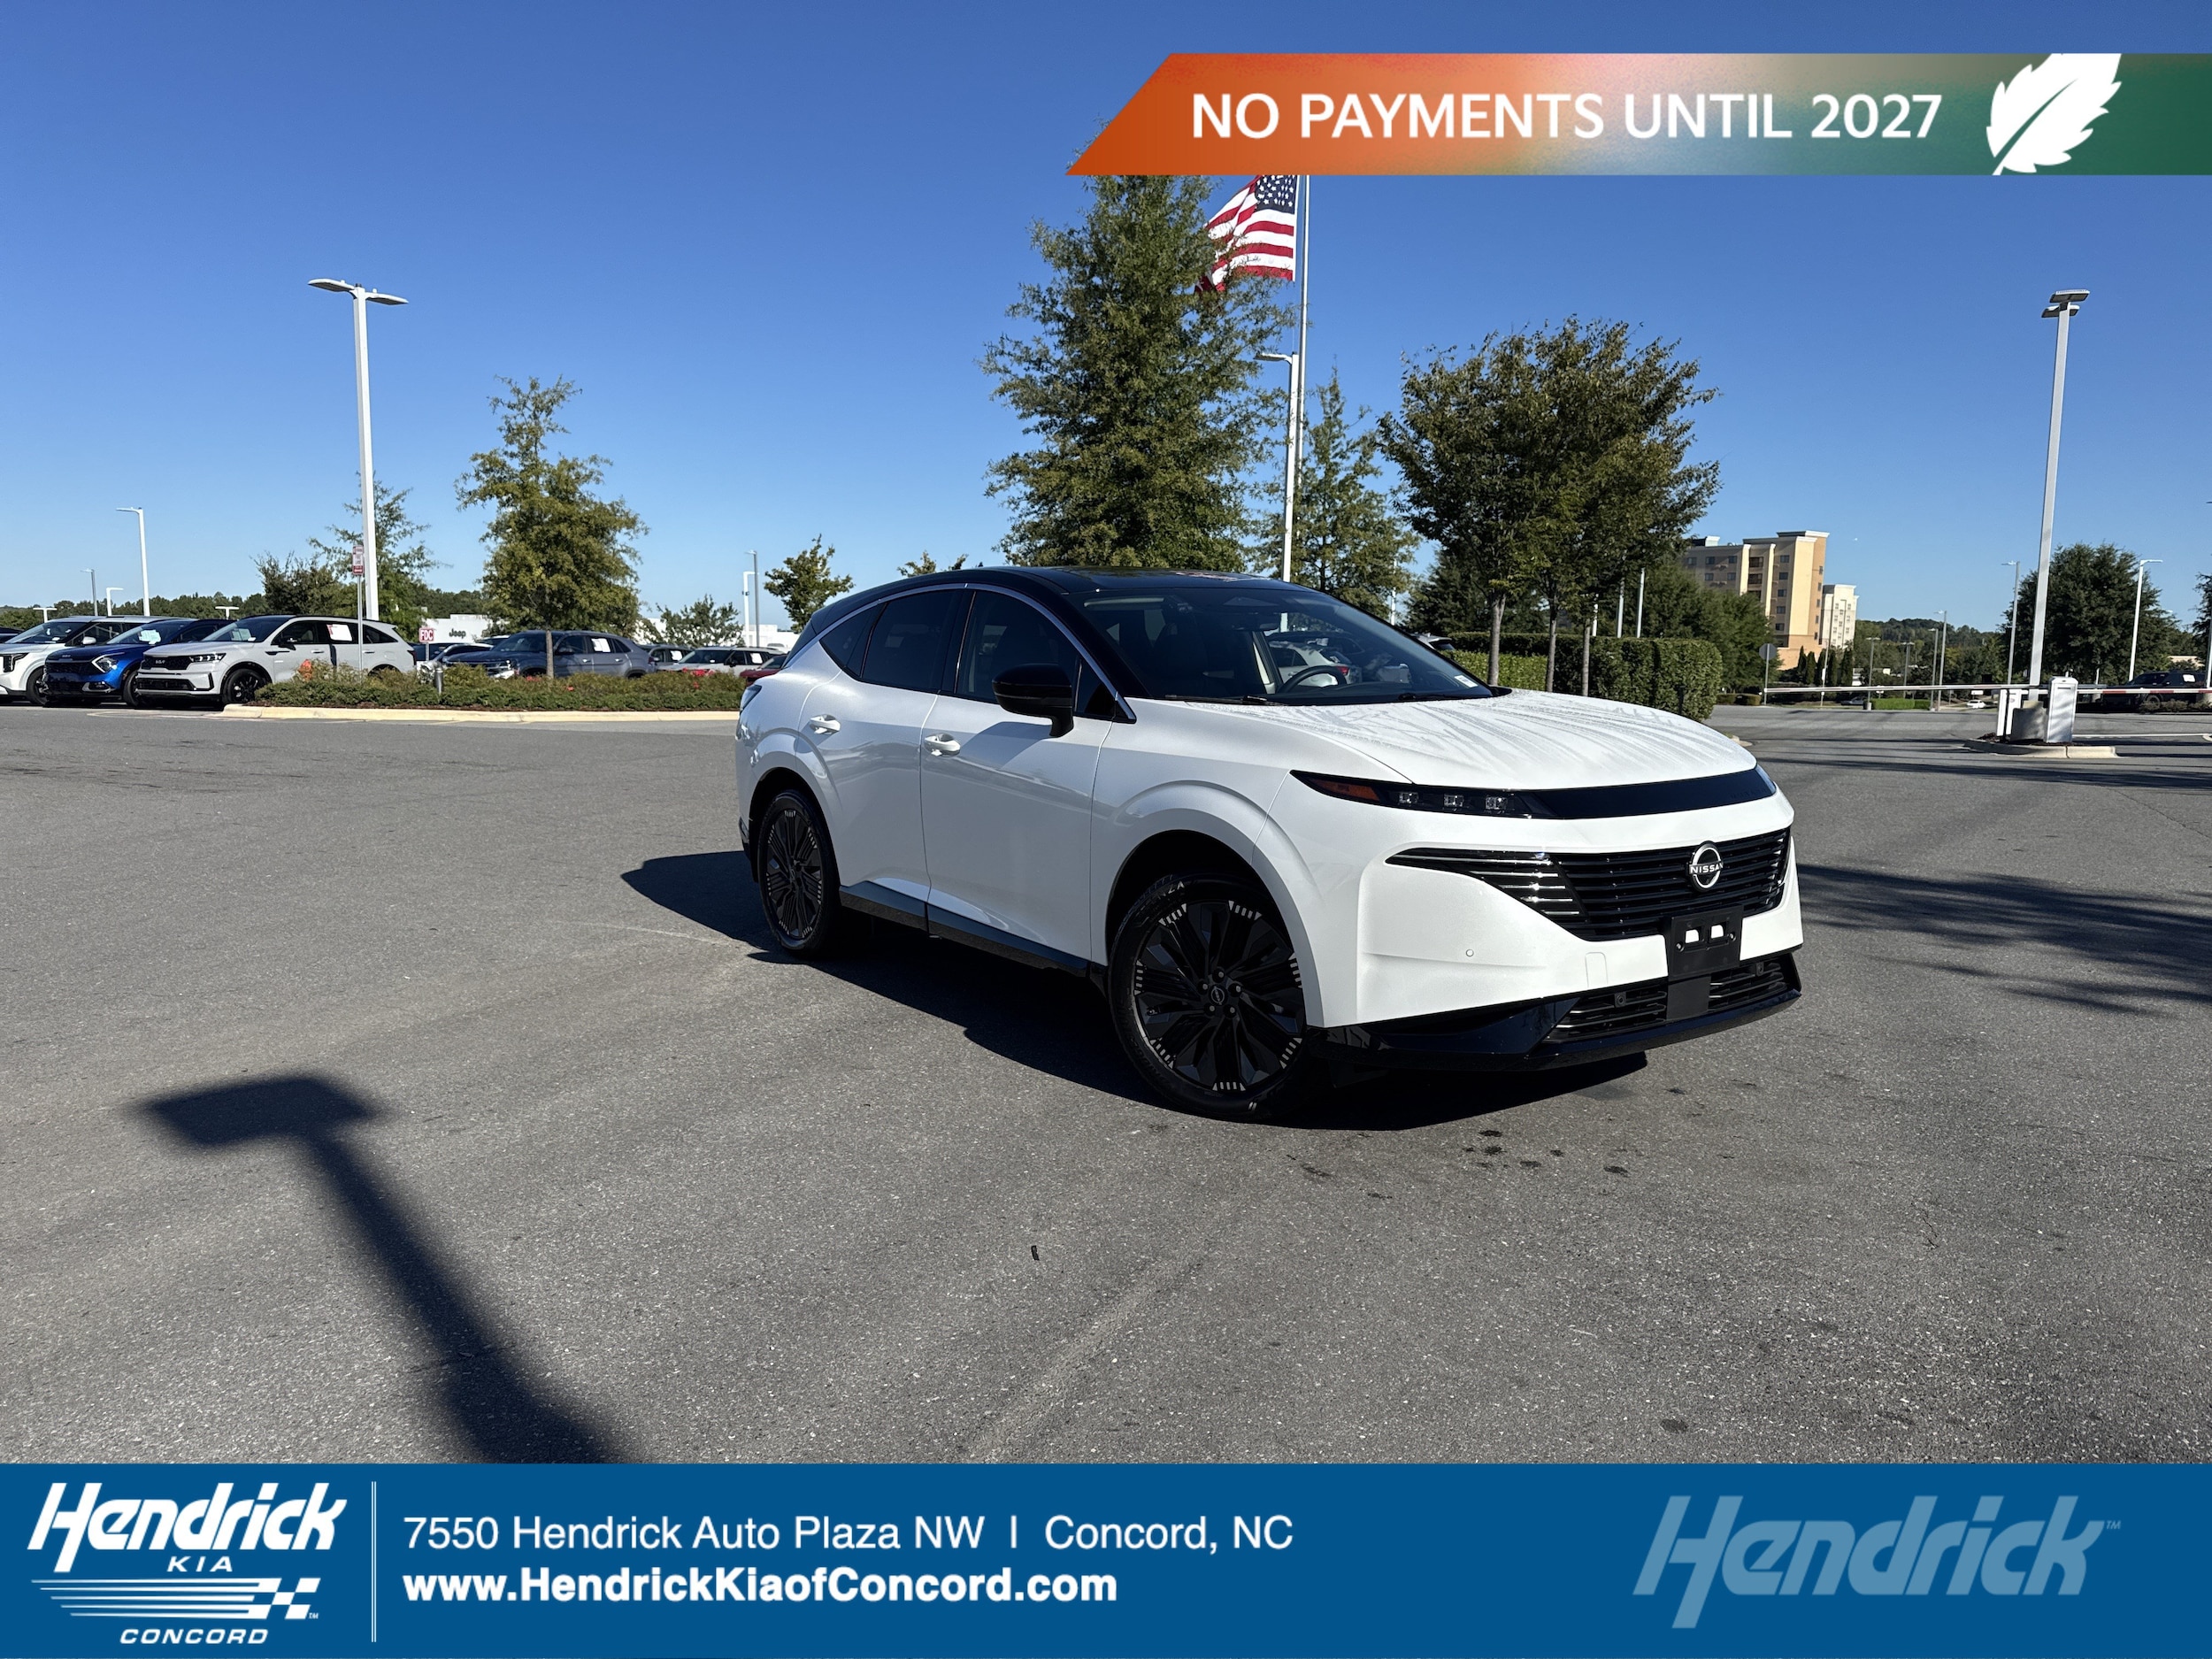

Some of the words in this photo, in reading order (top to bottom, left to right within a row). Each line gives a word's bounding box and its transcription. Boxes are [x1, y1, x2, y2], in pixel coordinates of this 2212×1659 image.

[420, 629, 434, 641] FDC
[449, 628, 466, 639] Jeep
[1690, 863, 1724, 874] NISSAN
